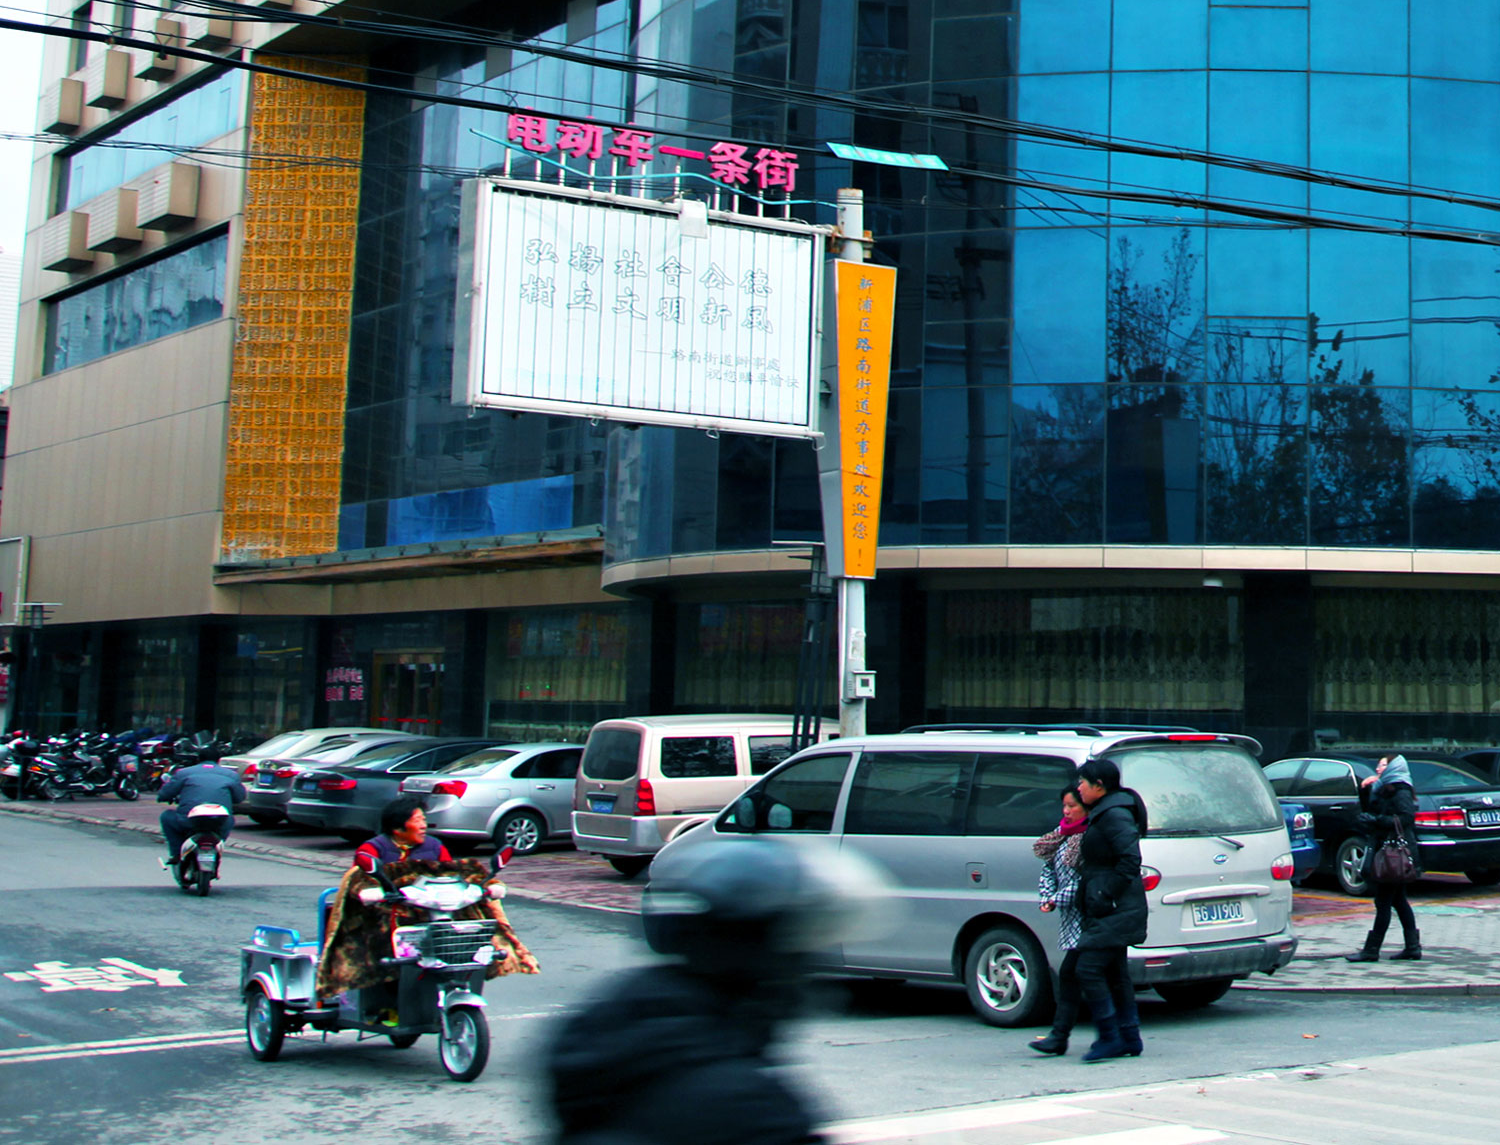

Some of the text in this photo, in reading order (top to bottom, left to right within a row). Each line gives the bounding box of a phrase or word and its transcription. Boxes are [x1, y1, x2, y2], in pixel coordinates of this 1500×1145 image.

[507, 106, 800, 192] 电动车一条街
